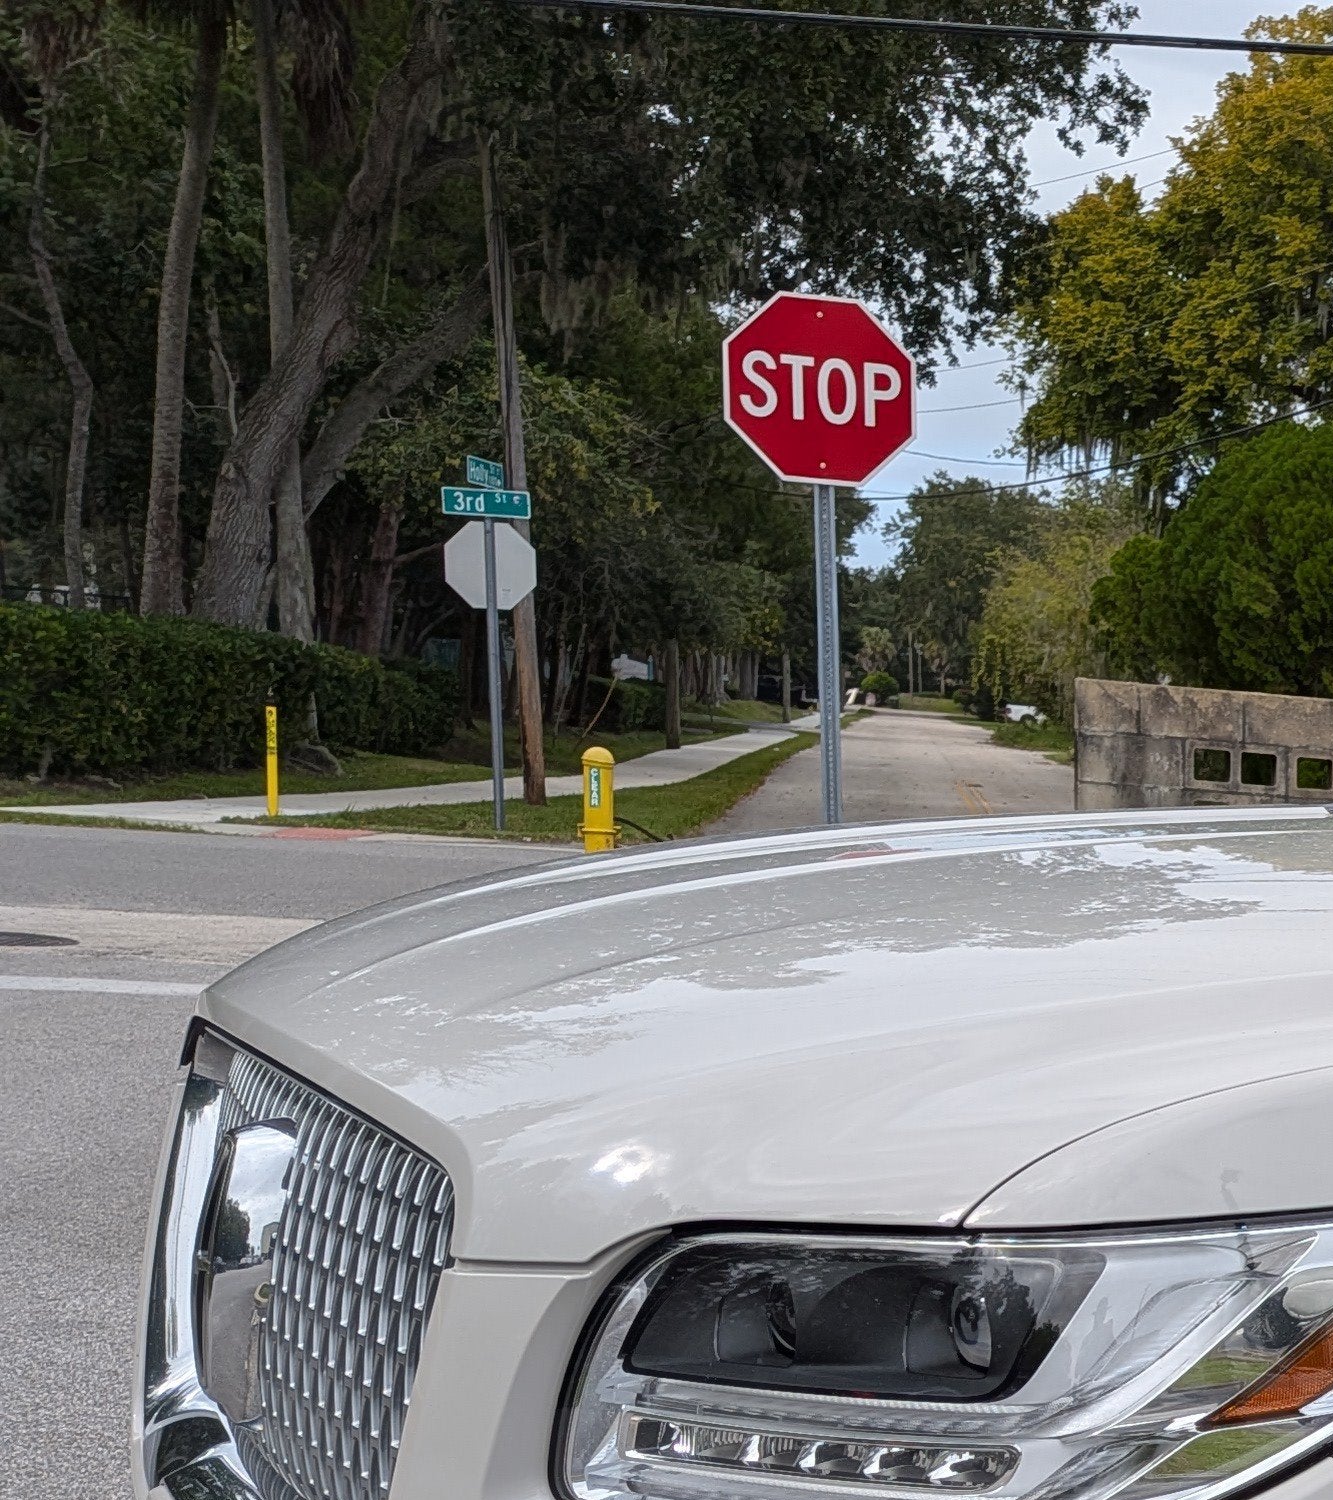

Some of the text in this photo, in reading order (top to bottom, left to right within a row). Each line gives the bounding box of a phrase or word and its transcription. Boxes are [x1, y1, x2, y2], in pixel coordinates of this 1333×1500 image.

[739, 350, 902, 428] STOP
[453, 491, 507, 512] 3rd St
